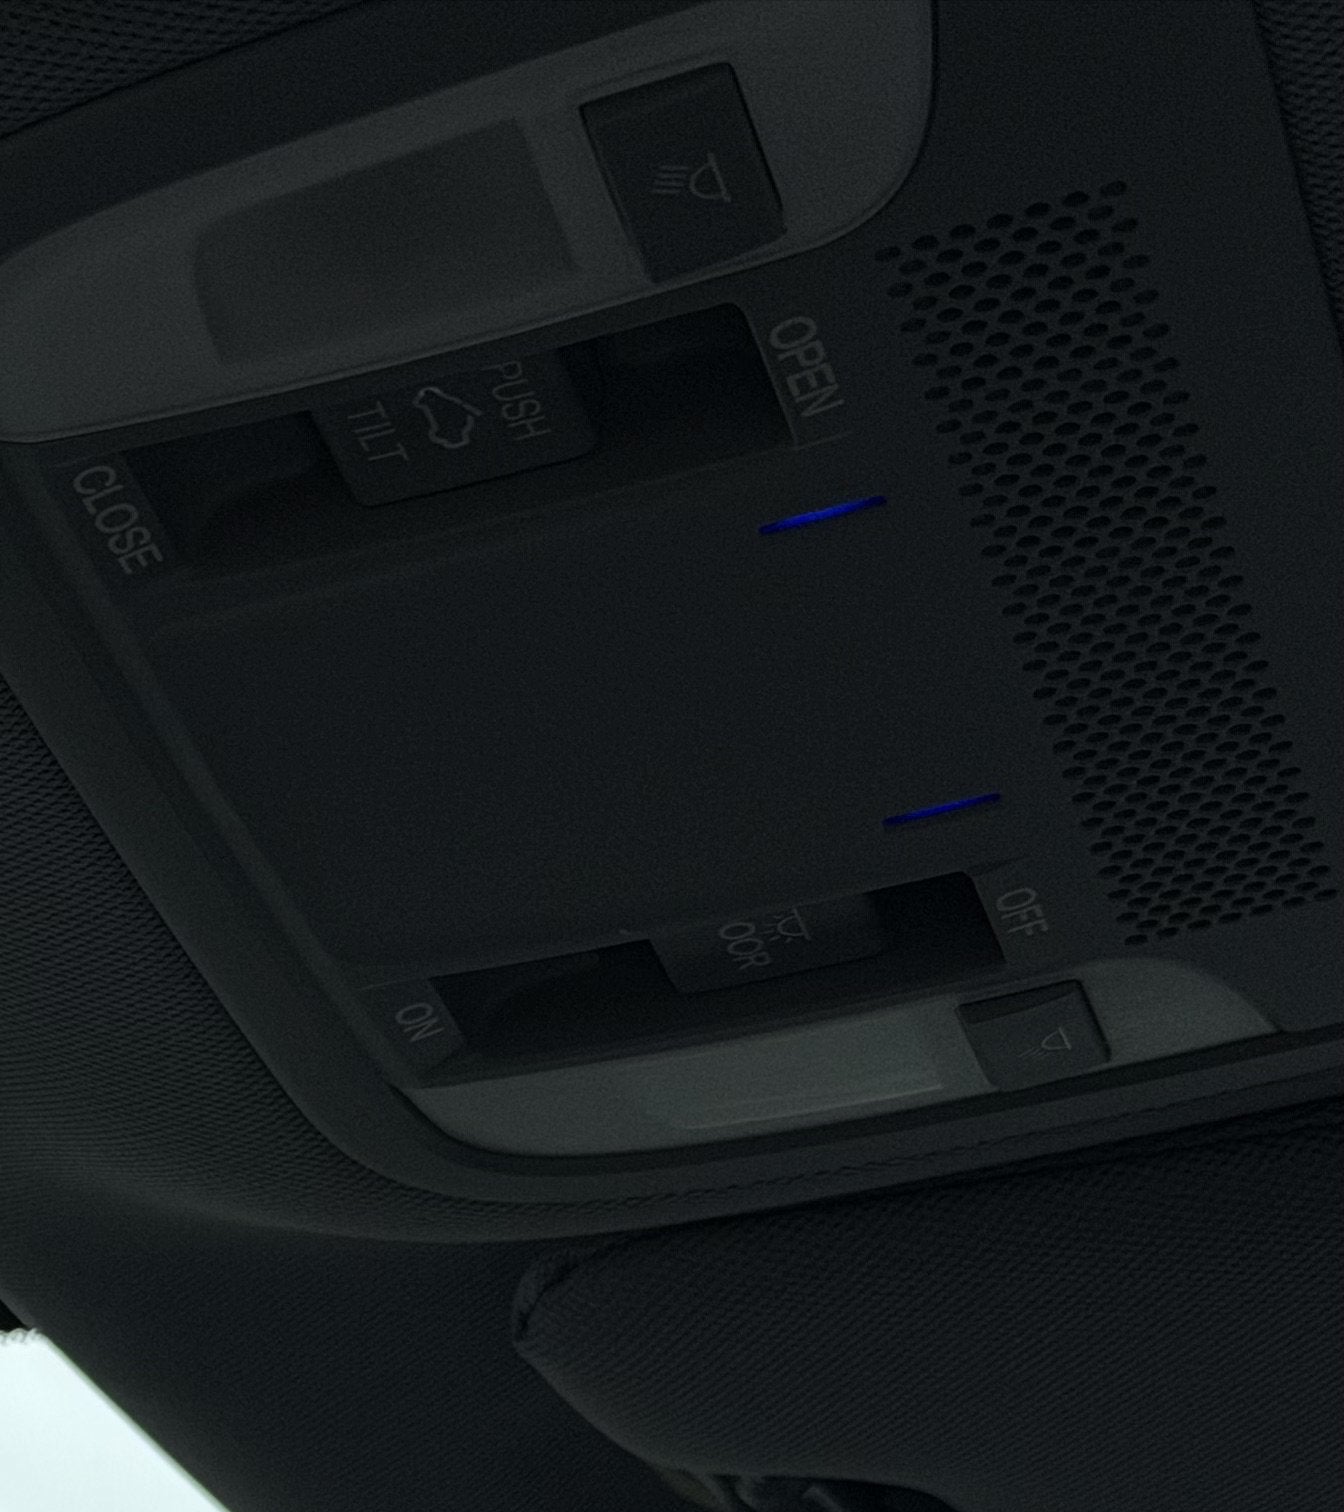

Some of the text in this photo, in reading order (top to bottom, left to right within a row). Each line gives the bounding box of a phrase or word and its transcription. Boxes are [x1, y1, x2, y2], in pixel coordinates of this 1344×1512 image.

[768, 315, 846, 418] OPEN
[346, 400, 411, 461] TILT
[480, 360, 554, 442] PUSH
[72, 463, 164, 575] CLOSE
[996, 886, 1049, 937] OFF
[717, 920, 773, 973] OOR
[395, 1002, 446, 1044] ON
